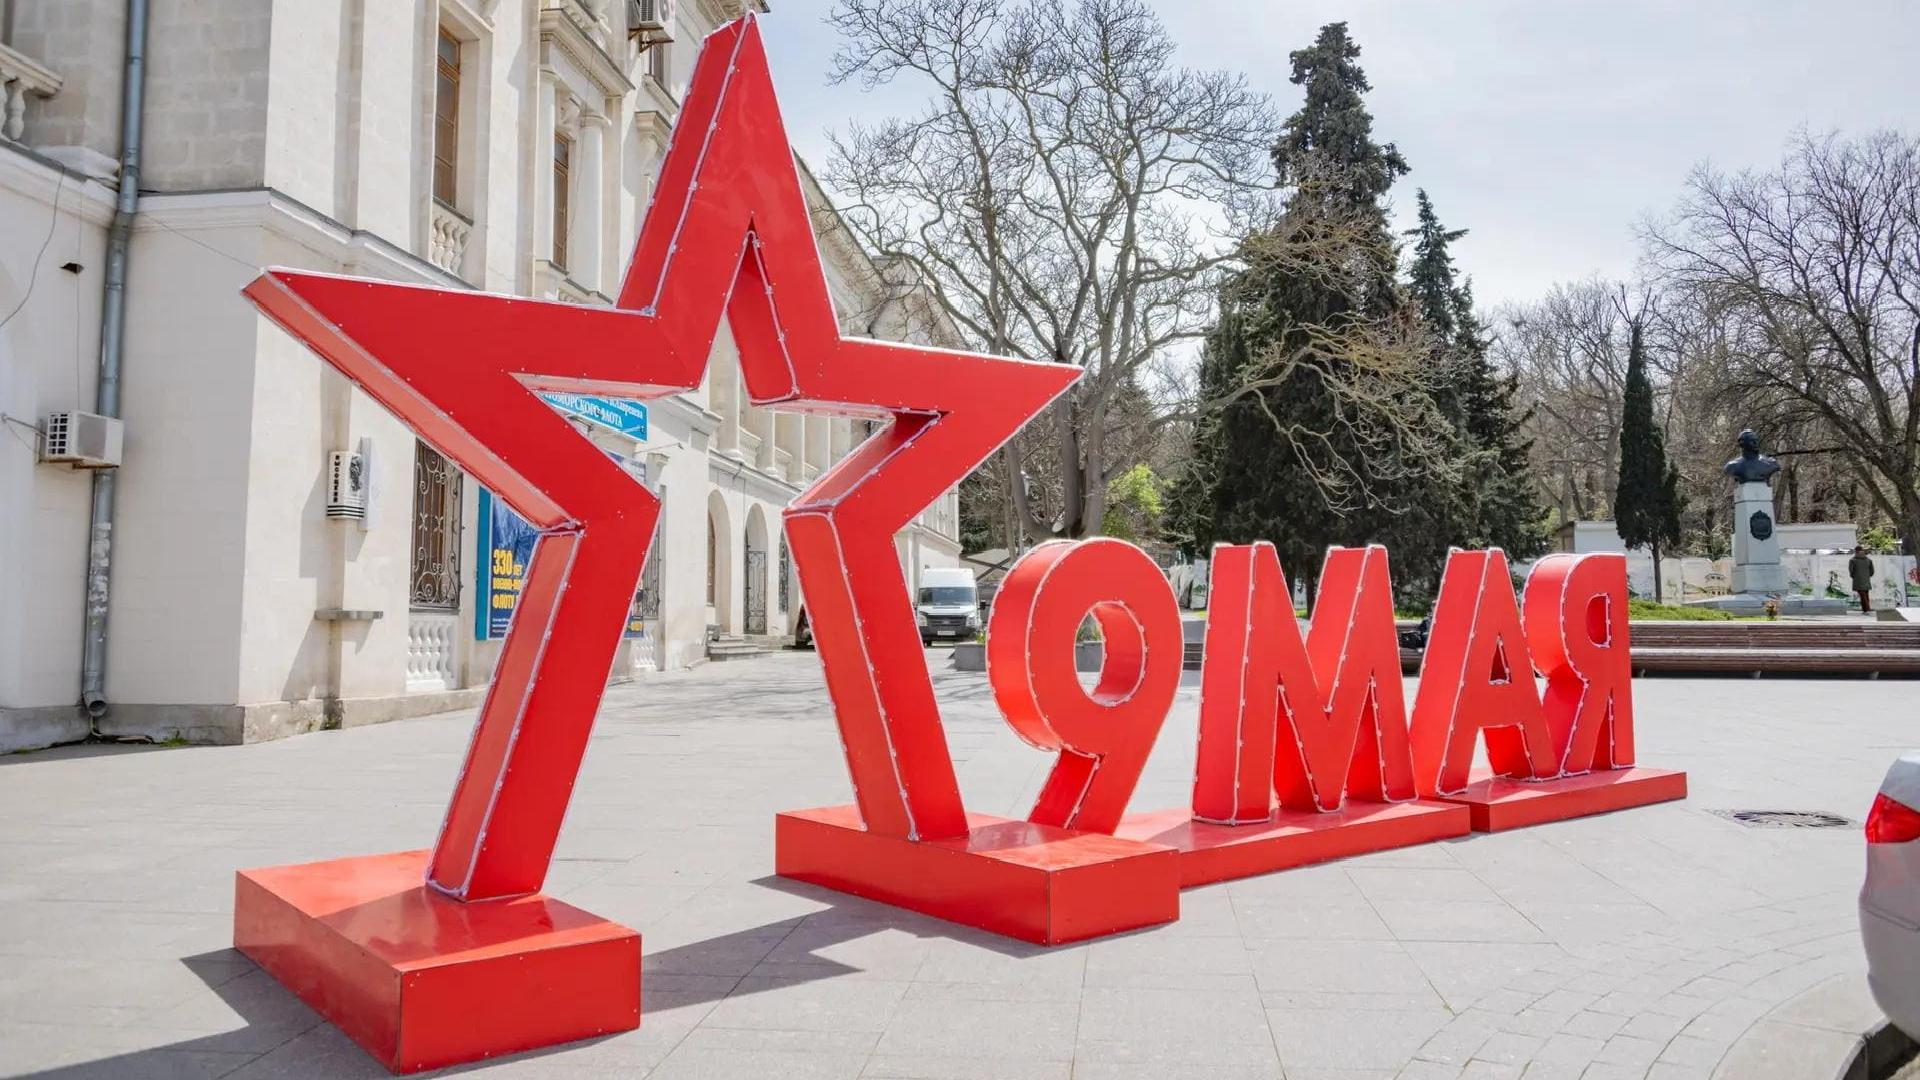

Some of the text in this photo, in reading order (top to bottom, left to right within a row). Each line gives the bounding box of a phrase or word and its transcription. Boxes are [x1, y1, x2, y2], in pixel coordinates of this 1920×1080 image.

[493, 549, 513, 576] 330
[986, 537, 1636, 836] 9 МАЯ
